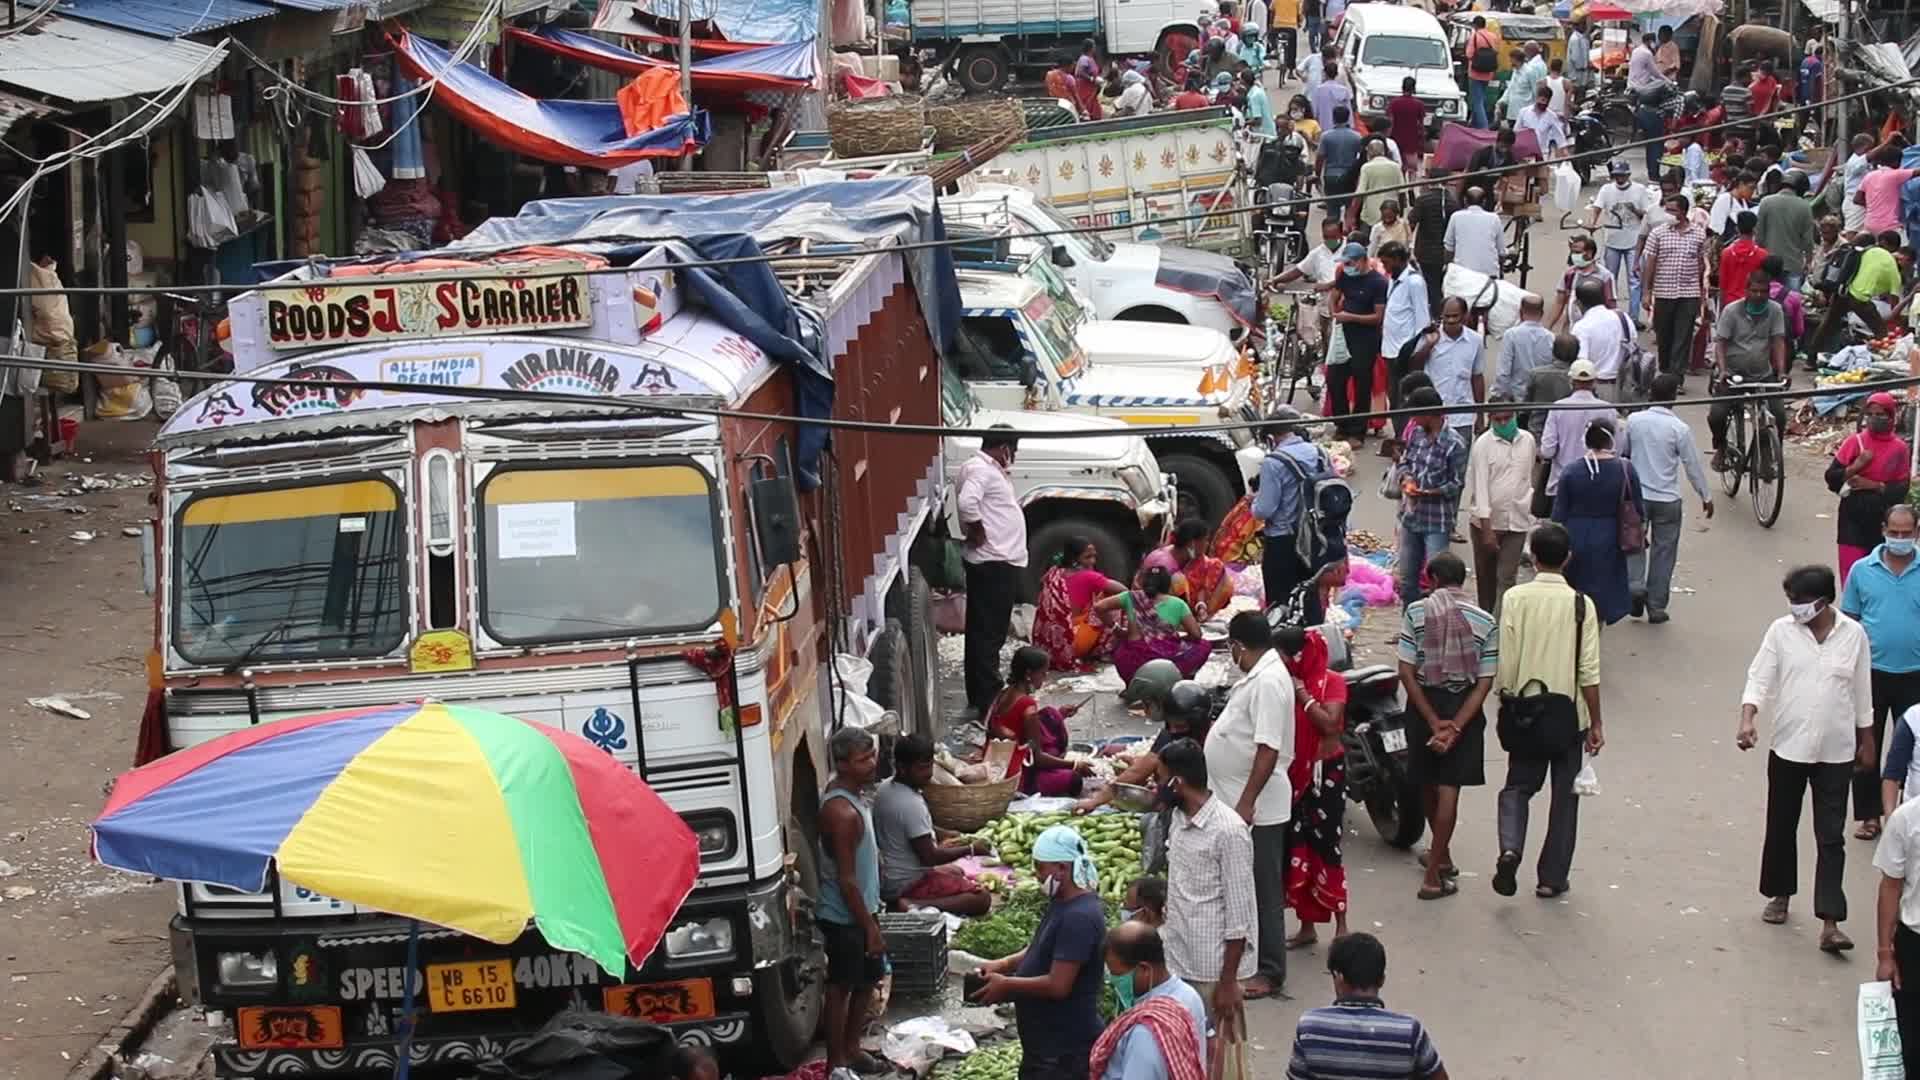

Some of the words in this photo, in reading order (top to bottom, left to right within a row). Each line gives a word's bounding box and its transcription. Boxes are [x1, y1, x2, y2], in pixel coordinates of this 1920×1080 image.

[268, 294, 371, 342] GOODS
[397, 370, 462, 386] PERMIT
[500, 348, 620, 394] NIRANKAR
[339, 966, 423, 1001] SPEED
[440, 967, 464, 987] WB
[478, 964, 499, 985] 15
[444, 988, 456, 1007] C
[462, 985, 507, 1007] 6610
